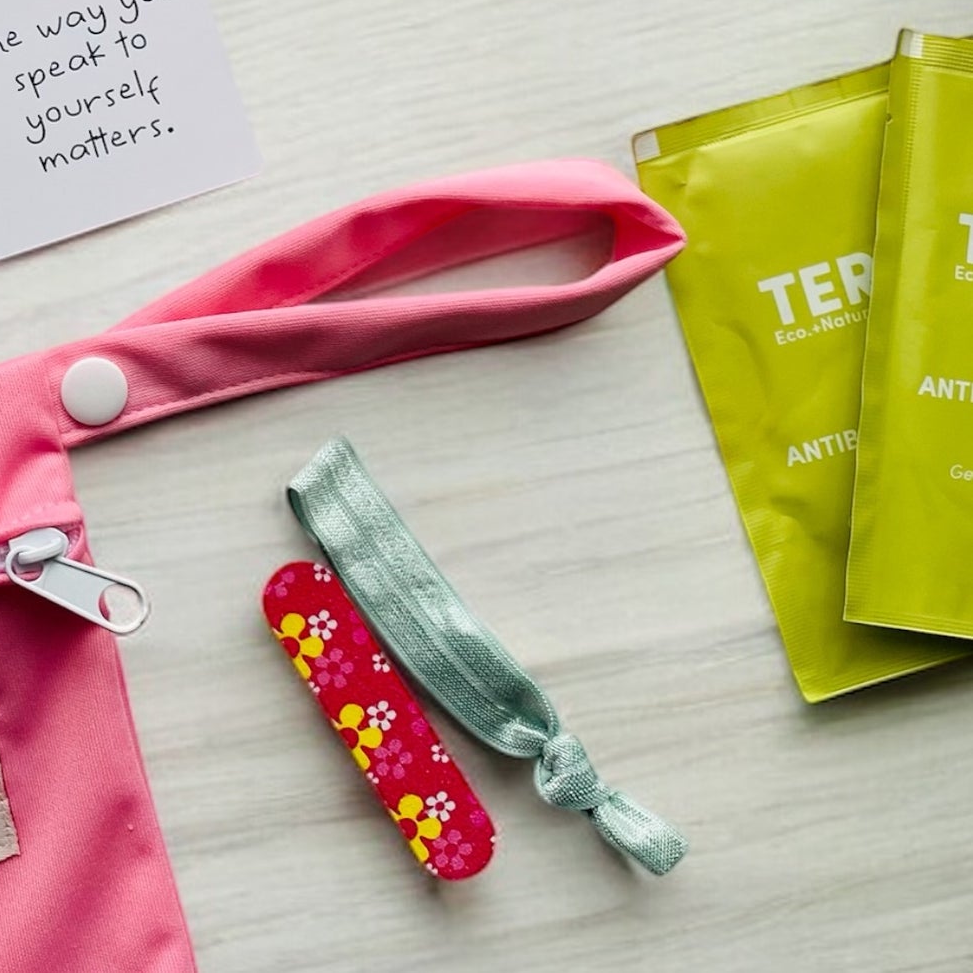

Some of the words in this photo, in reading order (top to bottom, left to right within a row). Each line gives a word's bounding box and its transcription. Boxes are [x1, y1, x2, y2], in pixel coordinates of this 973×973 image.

[37, 3, 107, 38] way
[14, 41, 106, 98] speak
[115, 30, 148, 58] to
[26, 70, 160, 144] yourself
[38, 119, 175, 173] matters.
